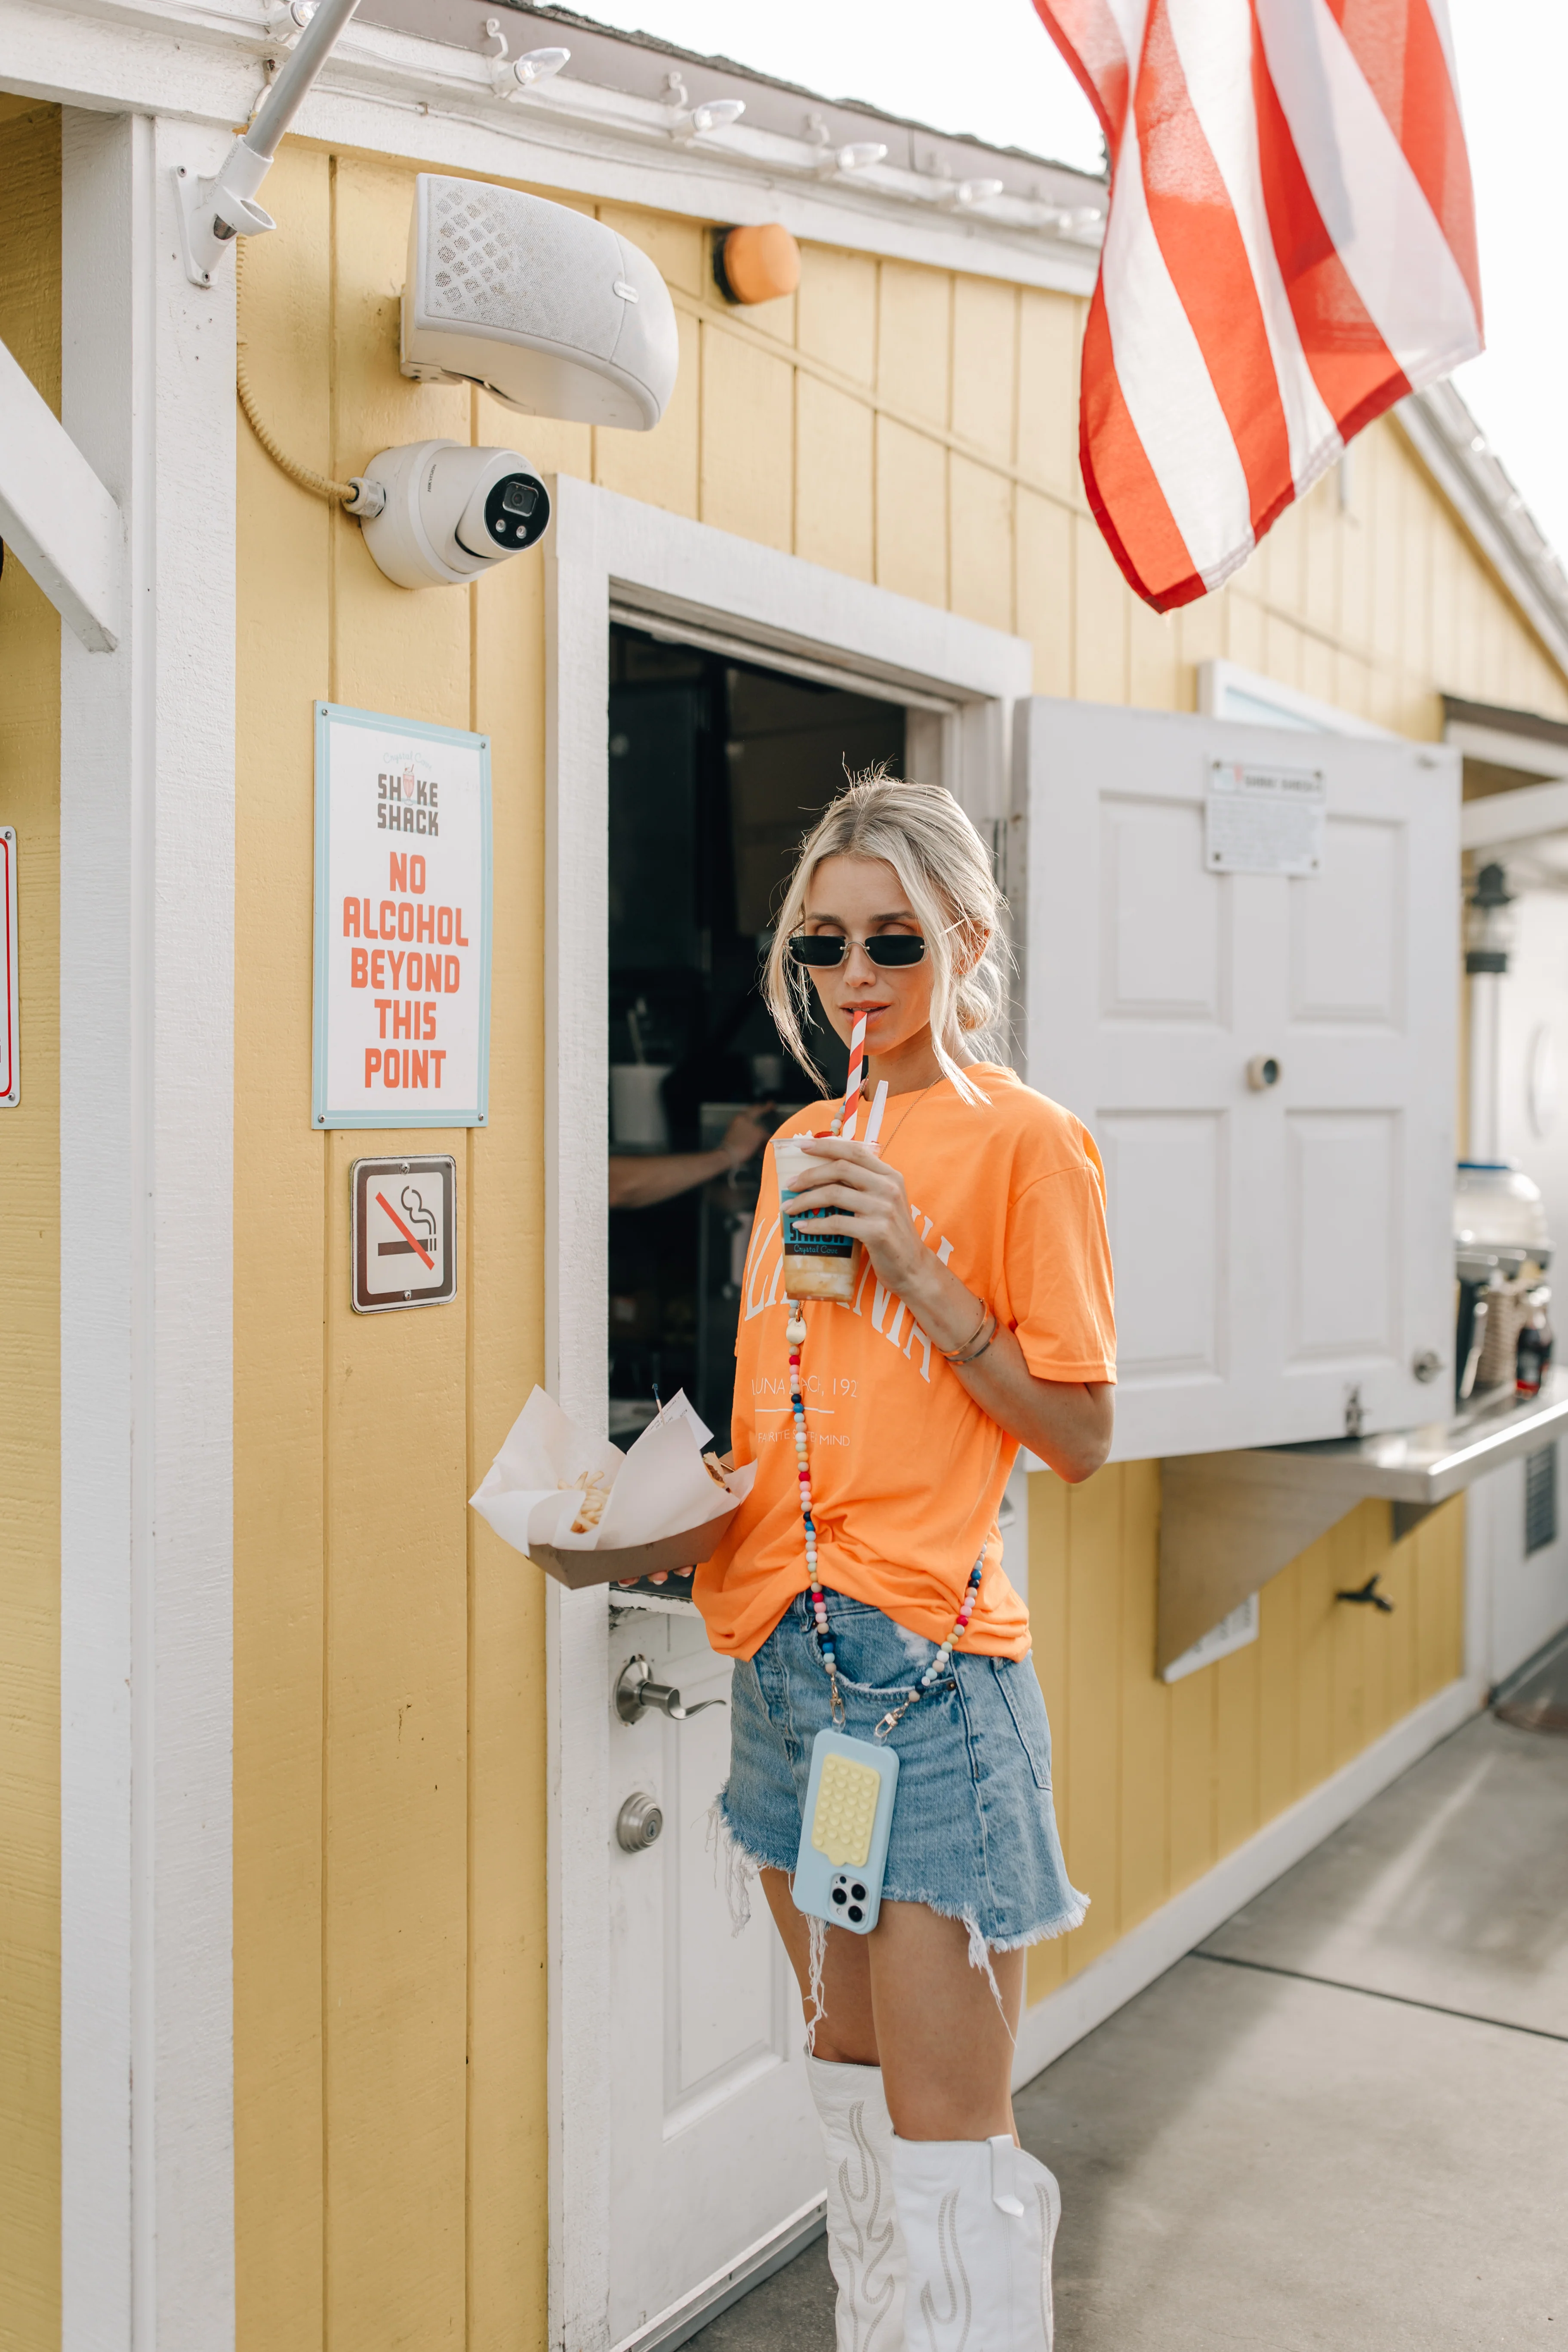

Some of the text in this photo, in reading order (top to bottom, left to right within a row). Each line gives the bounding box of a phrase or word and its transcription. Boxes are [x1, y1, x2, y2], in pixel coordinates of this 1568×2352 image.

[383, 750, 432, 771] Crystal Cove
[378, 774, 438, 808] SHKE
[377, 803, 438, 836] SHACK
[390, 852, 426, 894] NO
[343, 896, 469, 947] ALCOHOL
[351, 947, 460, 994] BEYOND
[374, 999, 437, 1041] THIS
[364, 1048, 447, 1088] POINT
[794, 1244, 838, 1255] Crystal Cove
[833, 1378, 859, 1398] 192
[819, 1434, 850, 1447] MIND
